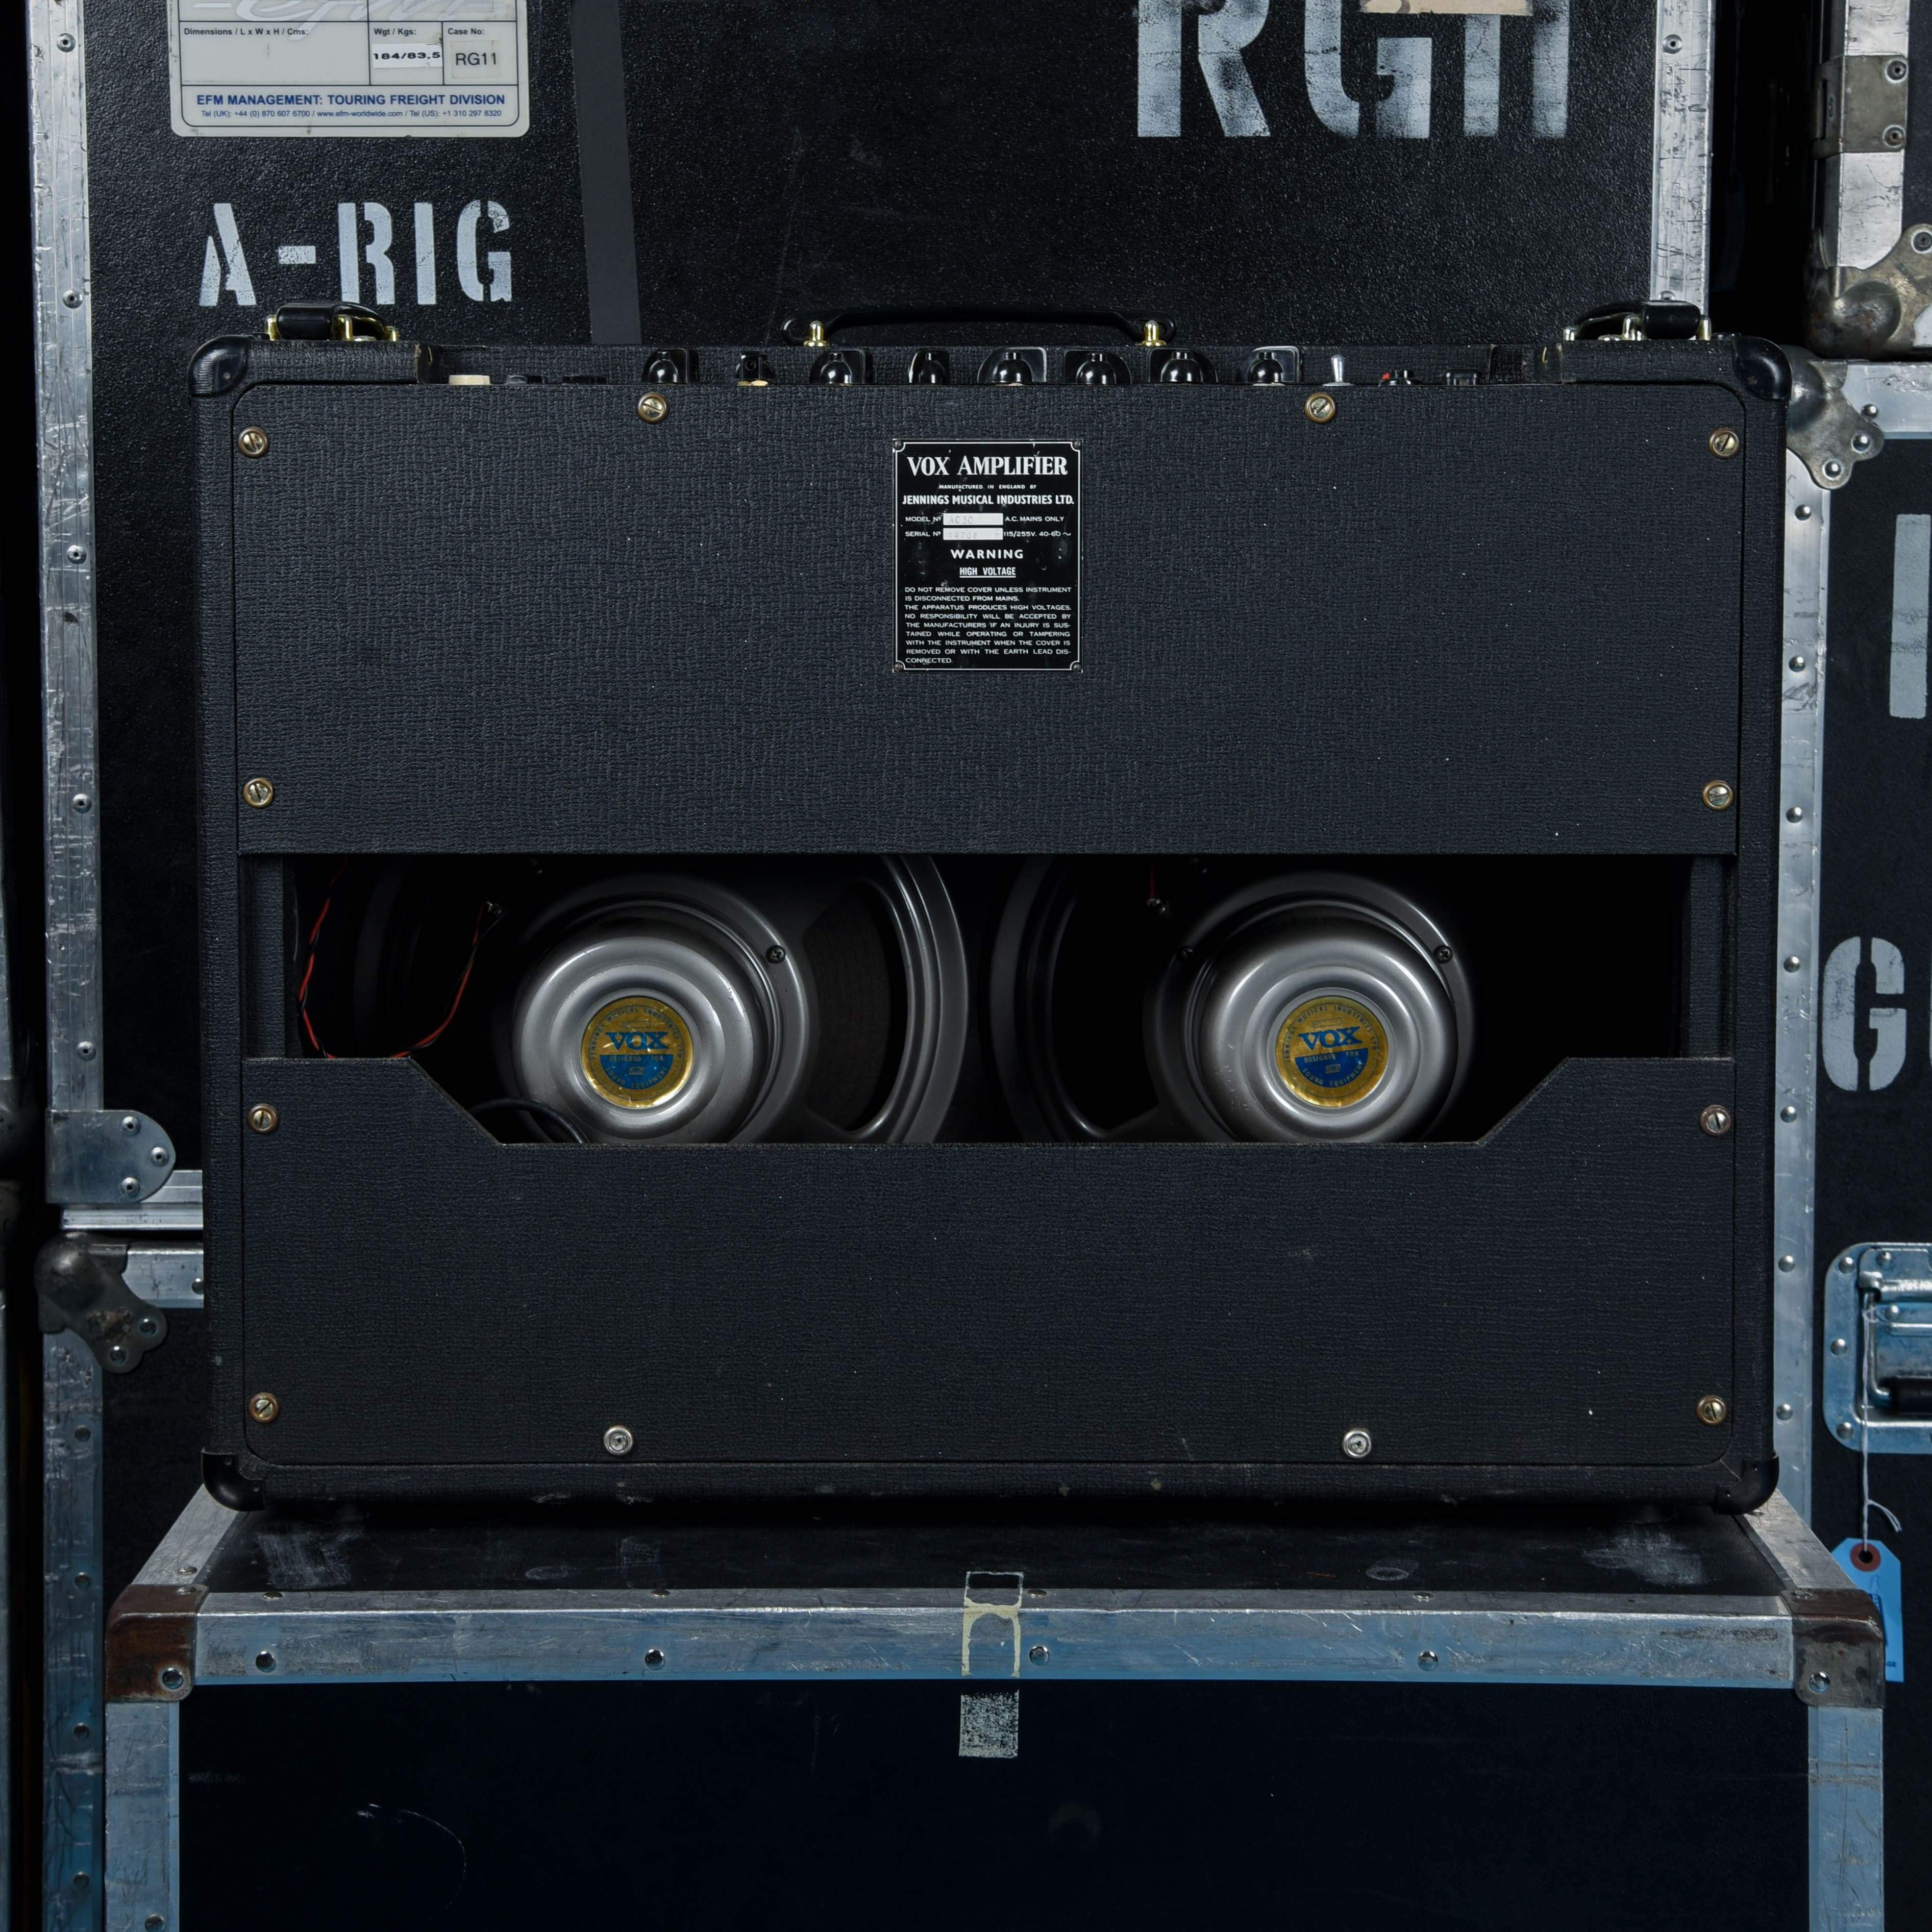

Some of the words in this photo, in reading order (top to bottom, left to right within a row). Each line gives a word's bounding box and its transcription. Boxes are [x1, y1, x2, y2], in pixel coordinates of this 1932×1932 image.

[374, 28, 390, 37] Wgt
[398, 28, 416, 37] Kgs:
[456, 52, 497, 66] RG11
[197, 95, 224, 105] EFM
[228, 95, 323, 105] MANAGEMENT:
[327, 95, 385, 105] TOURING
[390, 95, 445, 105] FREIGHT
[450, 95, 505, 105] DIVISION
[199, 200, 512, 306] A-RIG
[907, 456, 950, 476] VOX
[957, 455, 1068, 476] AMPLIFIER
[902, 495, 950, 505] JENNINGS
[952, 495, 994, 505] MUSICAL
[997, 495, 1052, 505] INDUSTRIES
[1055, 495, 1075, 505] LTD.
[950, 549, 1024, 559] WARNING
[959, 567, 978, 576] HIGH
[982, 567, 1016, 576] VOLTAGE
[605, 1031, 670, 1050] VOX
[1298, 1026, 1364, 1051] VOX
[1304, 1054, 1336, 1063] DESIGNED
[1302, 1069, 1324, 1085] SOUND
